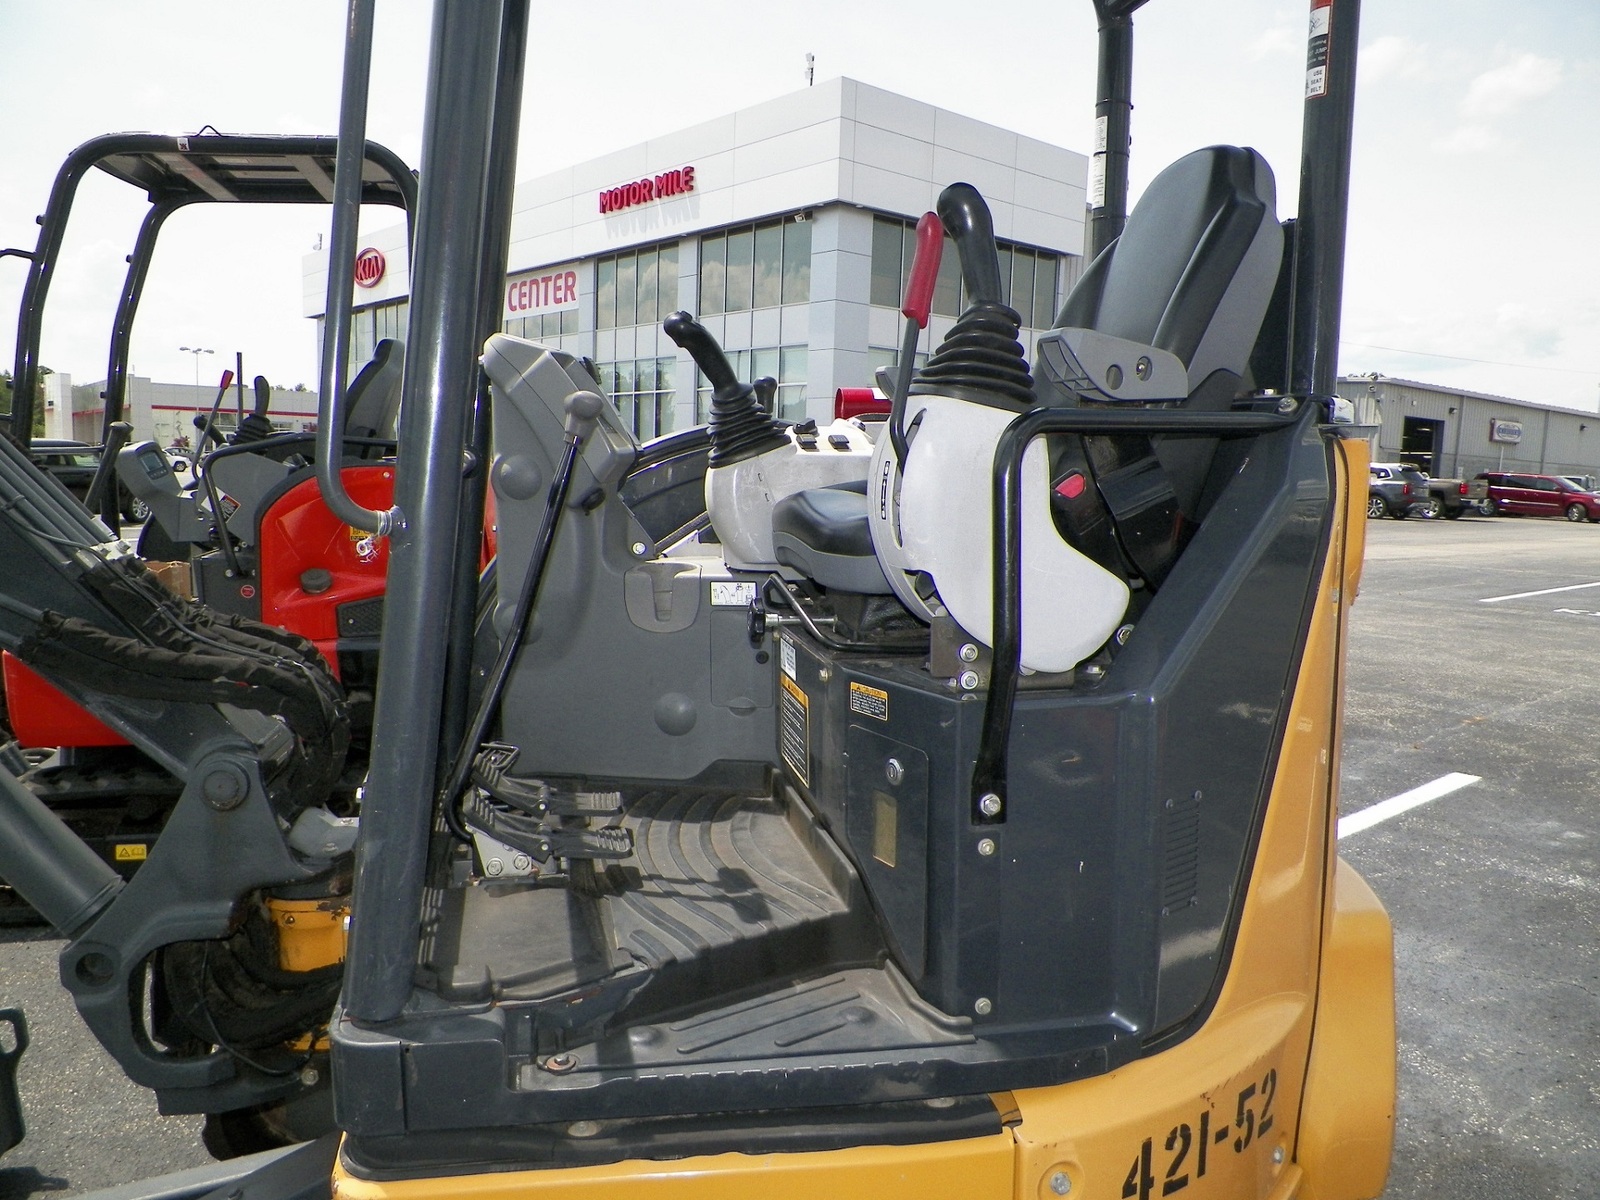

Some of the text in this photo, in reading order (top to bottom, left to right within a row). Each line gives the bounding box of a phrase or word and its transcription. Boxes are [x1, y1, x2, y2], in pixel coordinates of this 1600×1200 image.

[1310, 77, 1322, 85] SEAT
[1313, 69, 1323, 77] USE
[1310, 86, 1321, 94] BELT
[600, 165, 695, 214] MOTOR MILE
[356, 255, 380, 281] KIA
[508, 271, 577, 312] CENTER
[1122, 1068, 1277, 1200] 421-52
